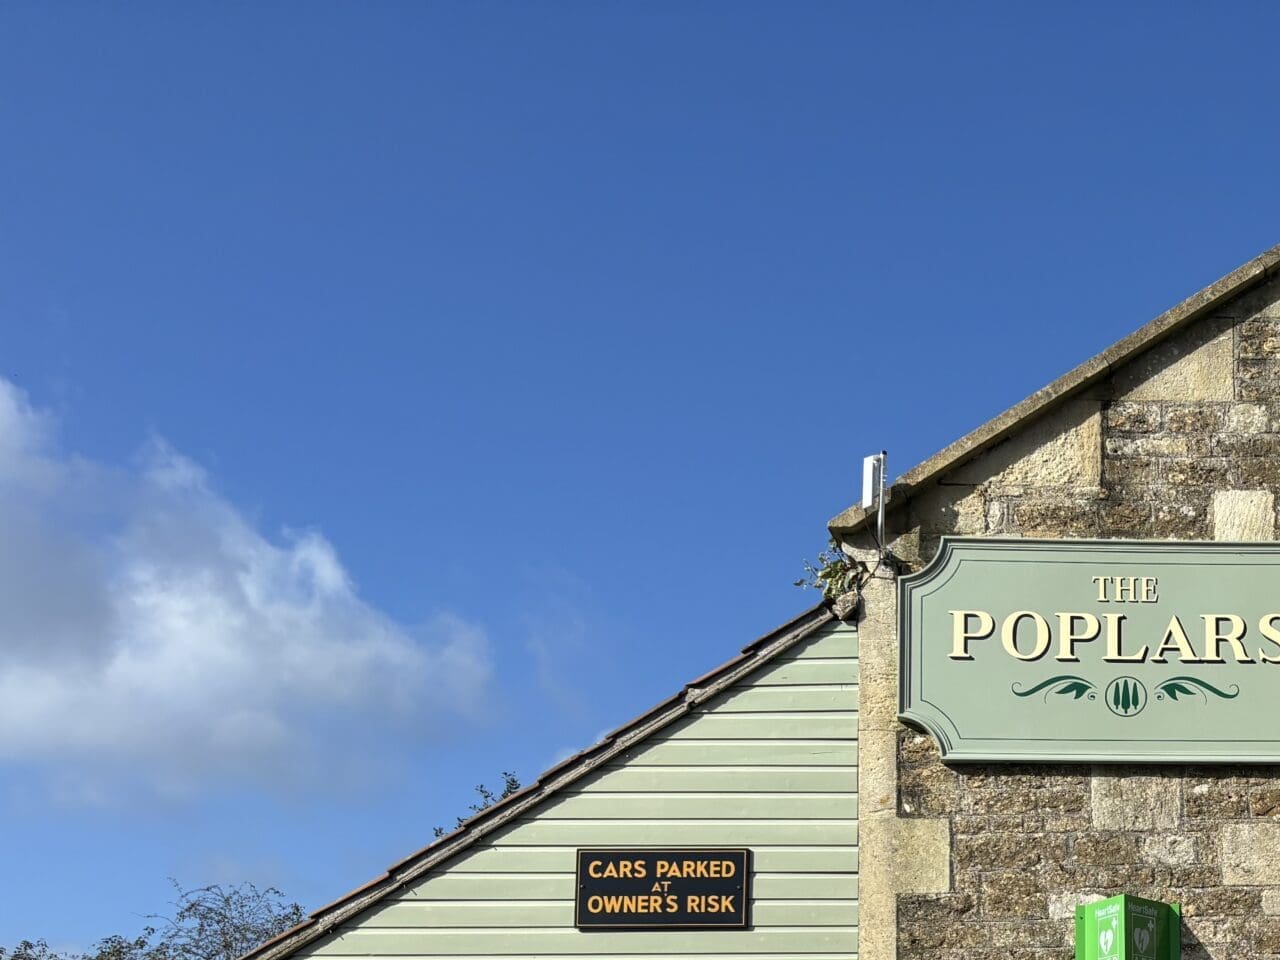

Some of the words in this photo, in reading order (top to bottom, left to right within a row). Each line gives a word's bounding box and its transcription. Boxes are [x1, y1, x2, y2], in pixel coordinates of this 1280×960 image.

[1092, 576, 1160, 603] THE
[588, 860, 647, 878] CARS
[656, 860, 736, 878] PARKED
[651, 881, 672, 892] AT
[587, 893, 679, 913] OWNER'S
[687, 895, 736, 913] RISK
